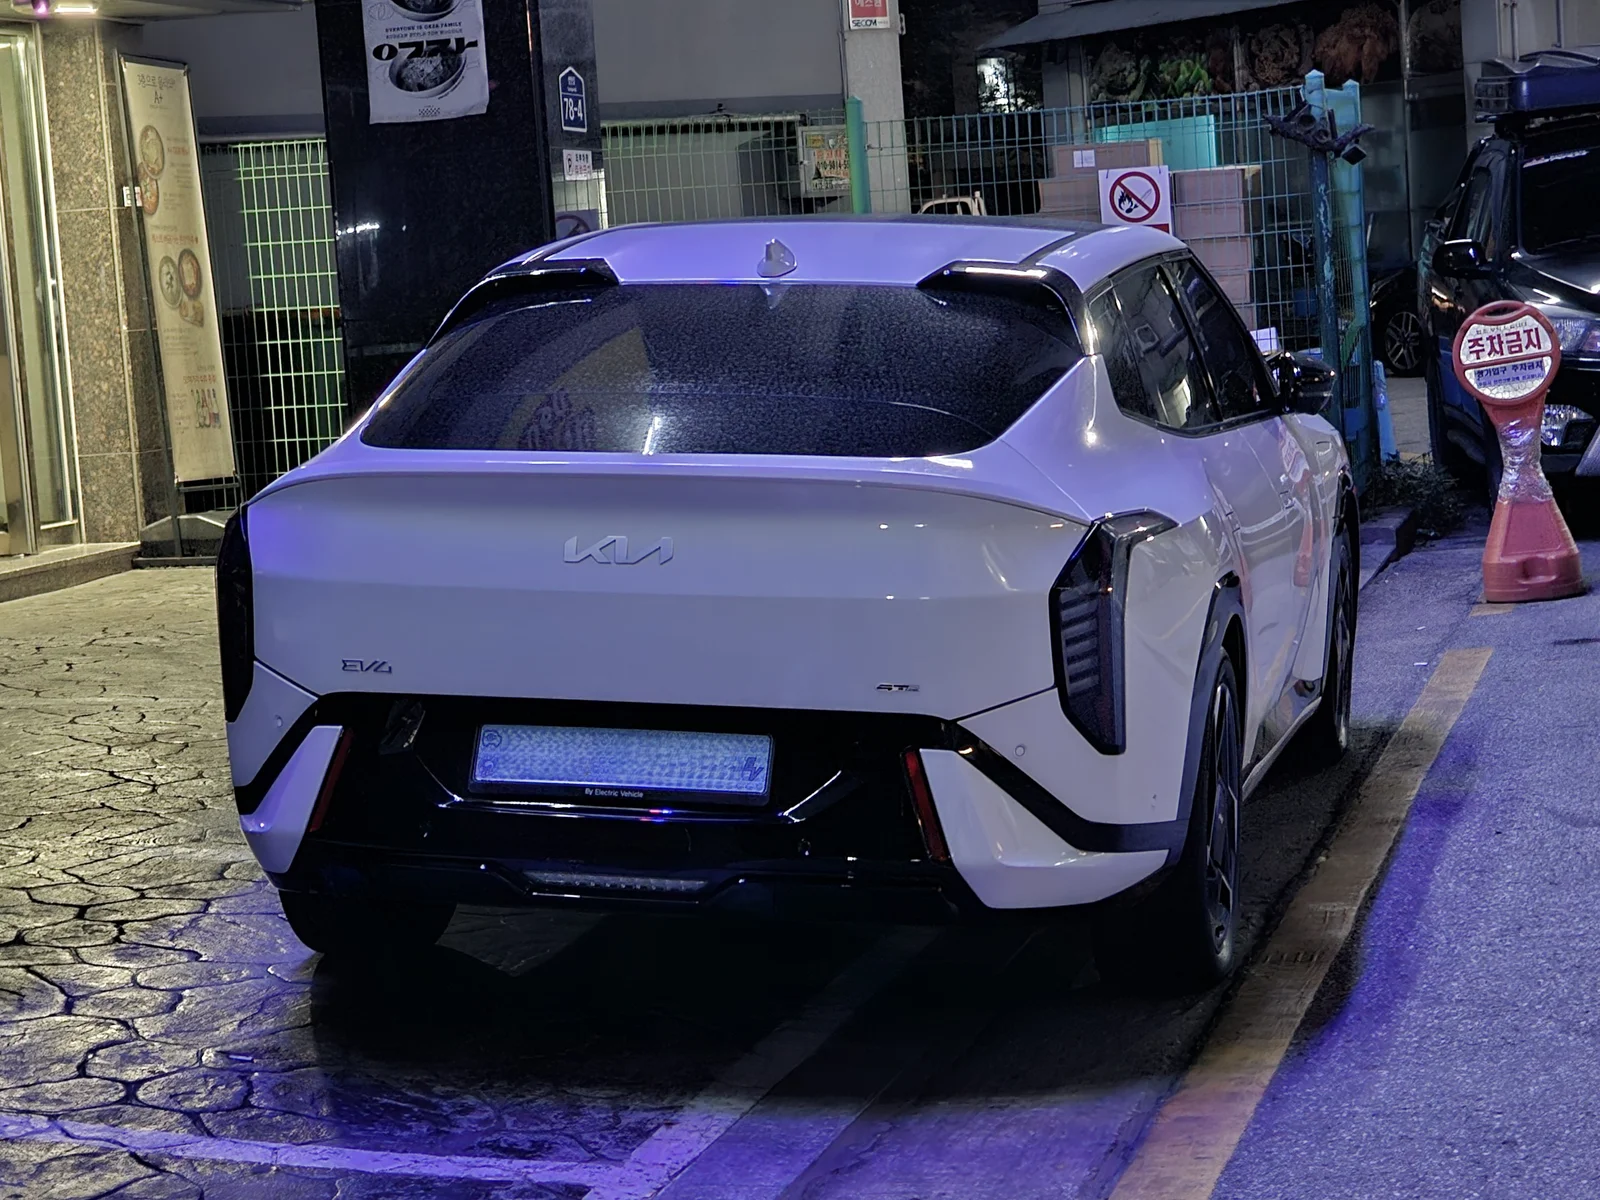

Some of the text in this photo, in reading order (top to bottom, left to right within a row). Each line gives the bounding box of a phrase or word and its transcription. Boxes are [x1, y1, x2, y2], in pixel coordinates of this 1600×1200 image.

[852, 19, 878, 27] SECOM
[154, 90, 163, 104] A+
[563, 97, 584, 121] 78-4
[1468, 327, 1542, 360] 주차금지
[563, 535, 675, 565] KIA
[584, 787, 644, 798] By Electric Vehicle
